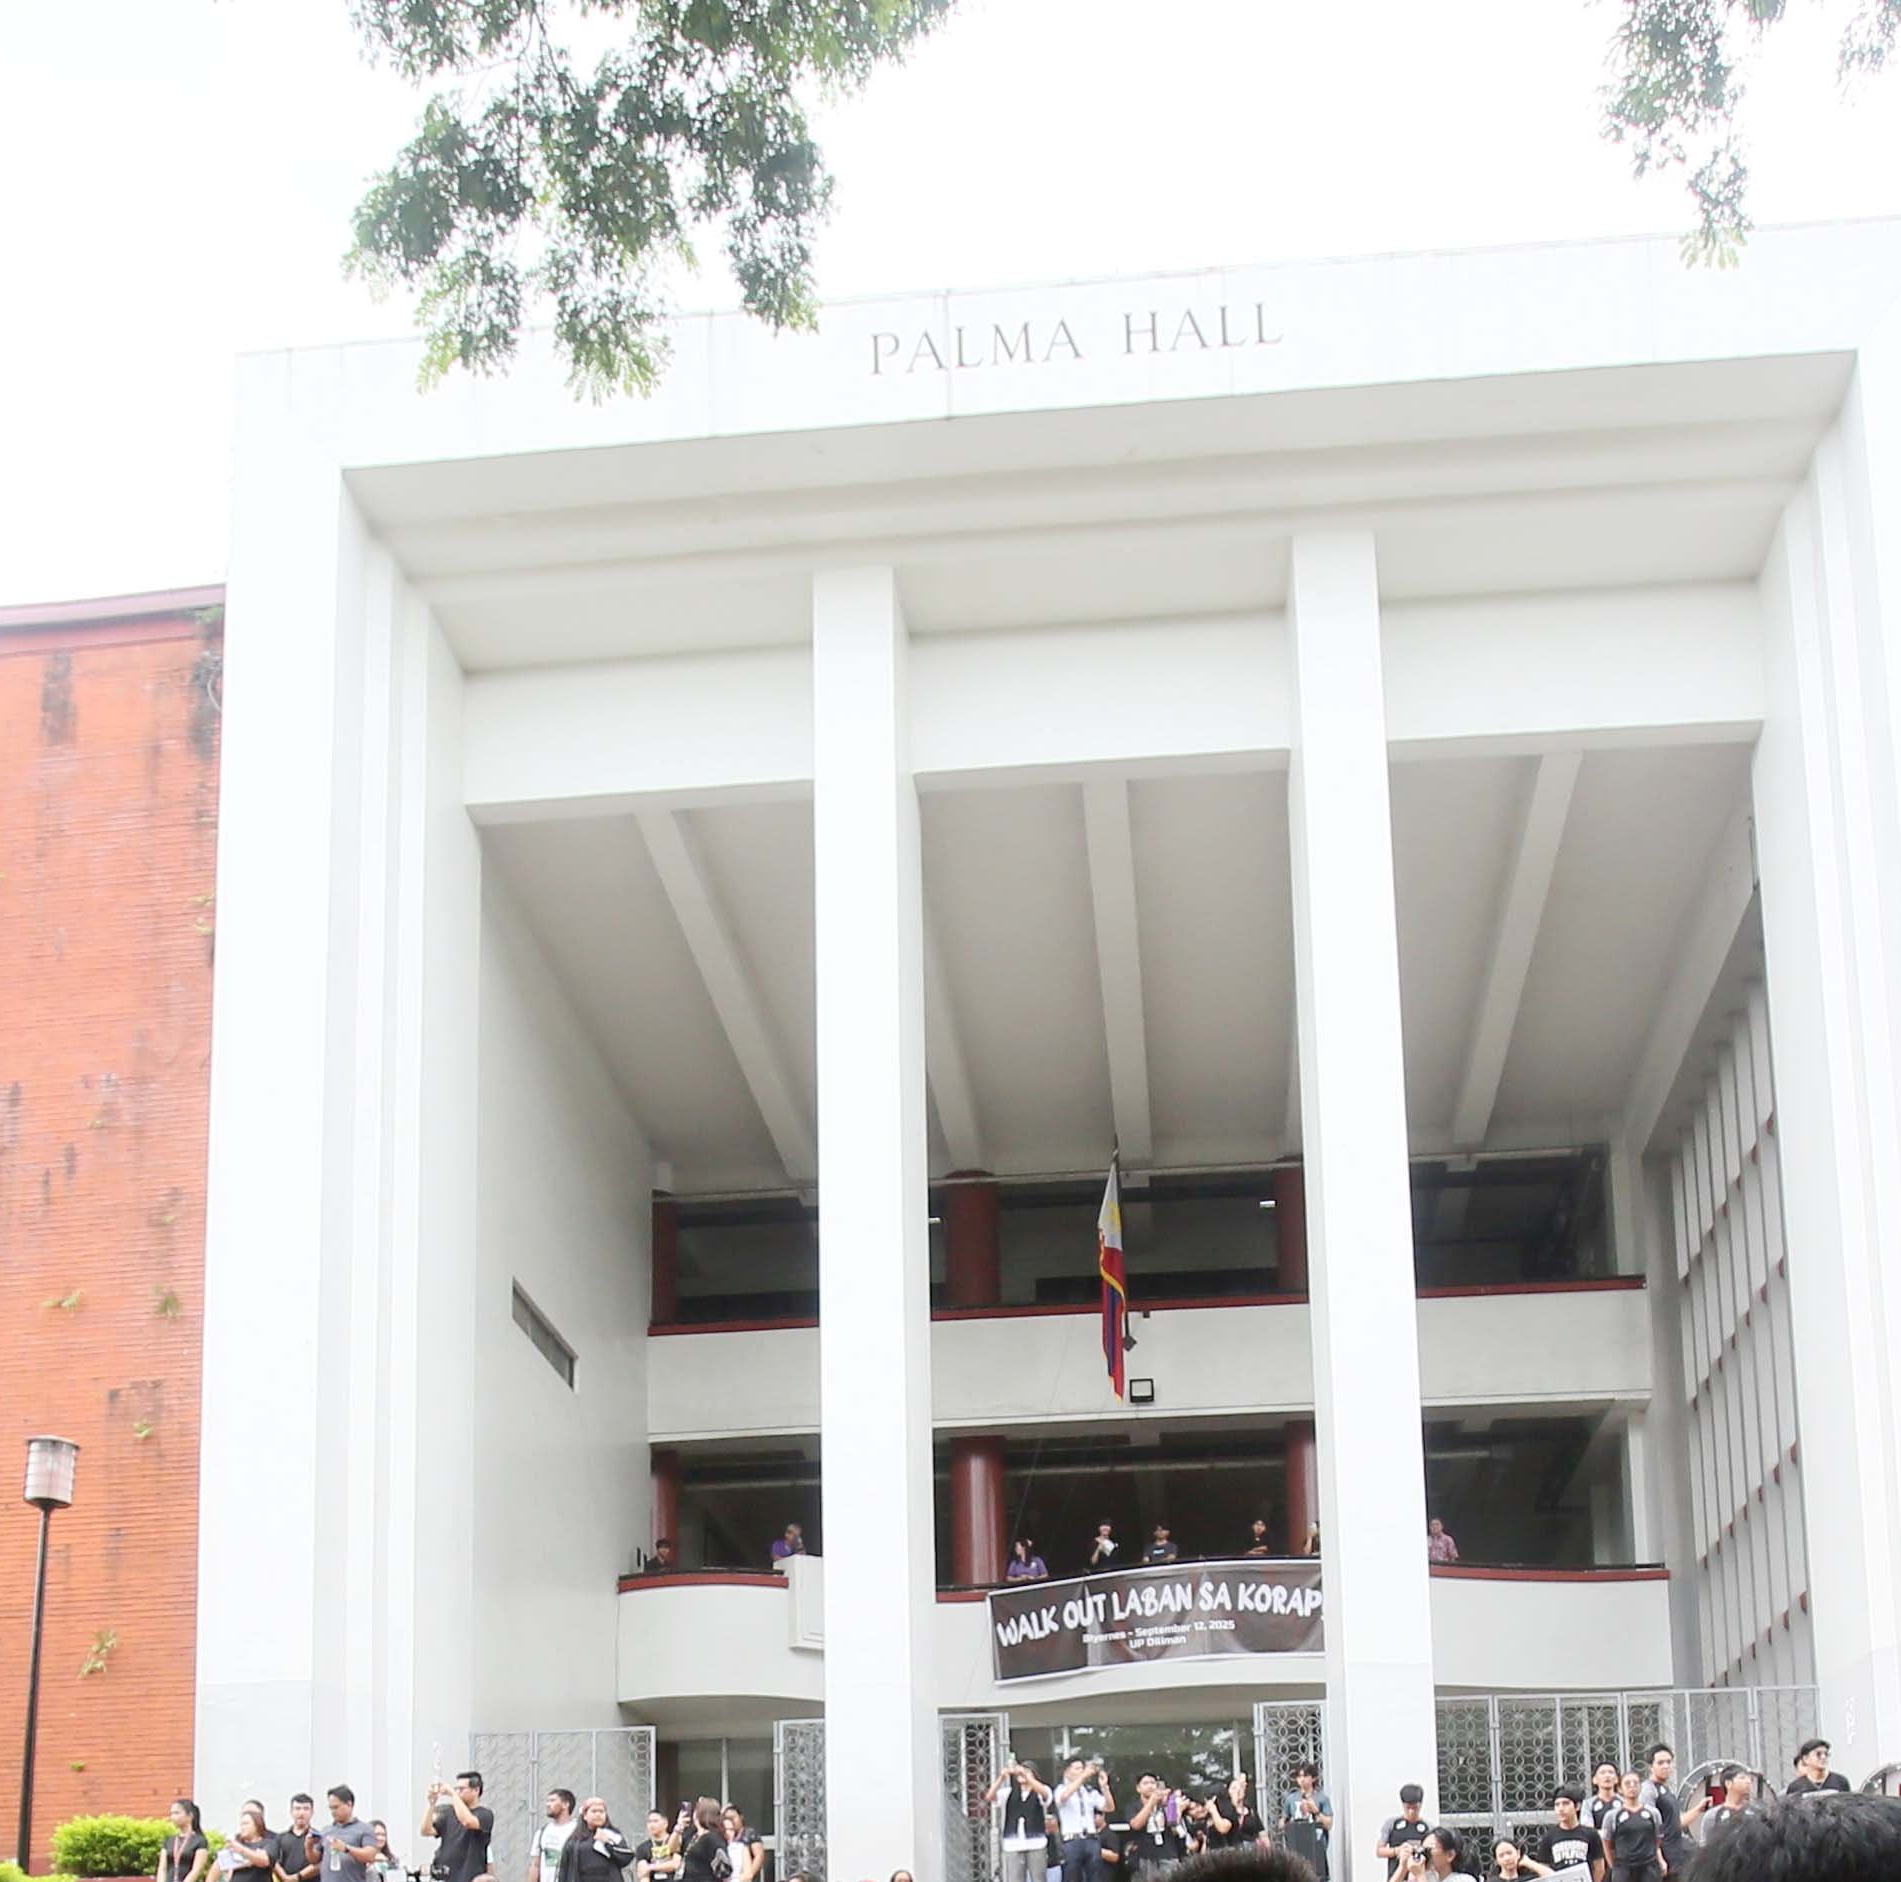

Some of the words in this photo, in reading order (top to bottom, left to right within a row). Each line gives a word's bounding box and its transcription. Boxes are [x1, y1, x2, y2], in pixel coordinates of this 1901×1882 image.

[869, 316, 1085, 376] PALMA
[1122, 301, 1286, 355] HALL
[997, 1606, 1059, 1648] WALK
[1062, 1592, 1108, 1630] OUT
[1112, 1583, 1192, 1621] LABAN
[1199, 1581, 1232, 1612] SA
[1134, 1622, 1193, 1638] September
[1208, 1619, 1236, 1631] 2025
[1128, 1638, 1145, 1649] UP
[1146, 1635, 1187, 1647] Diliman
